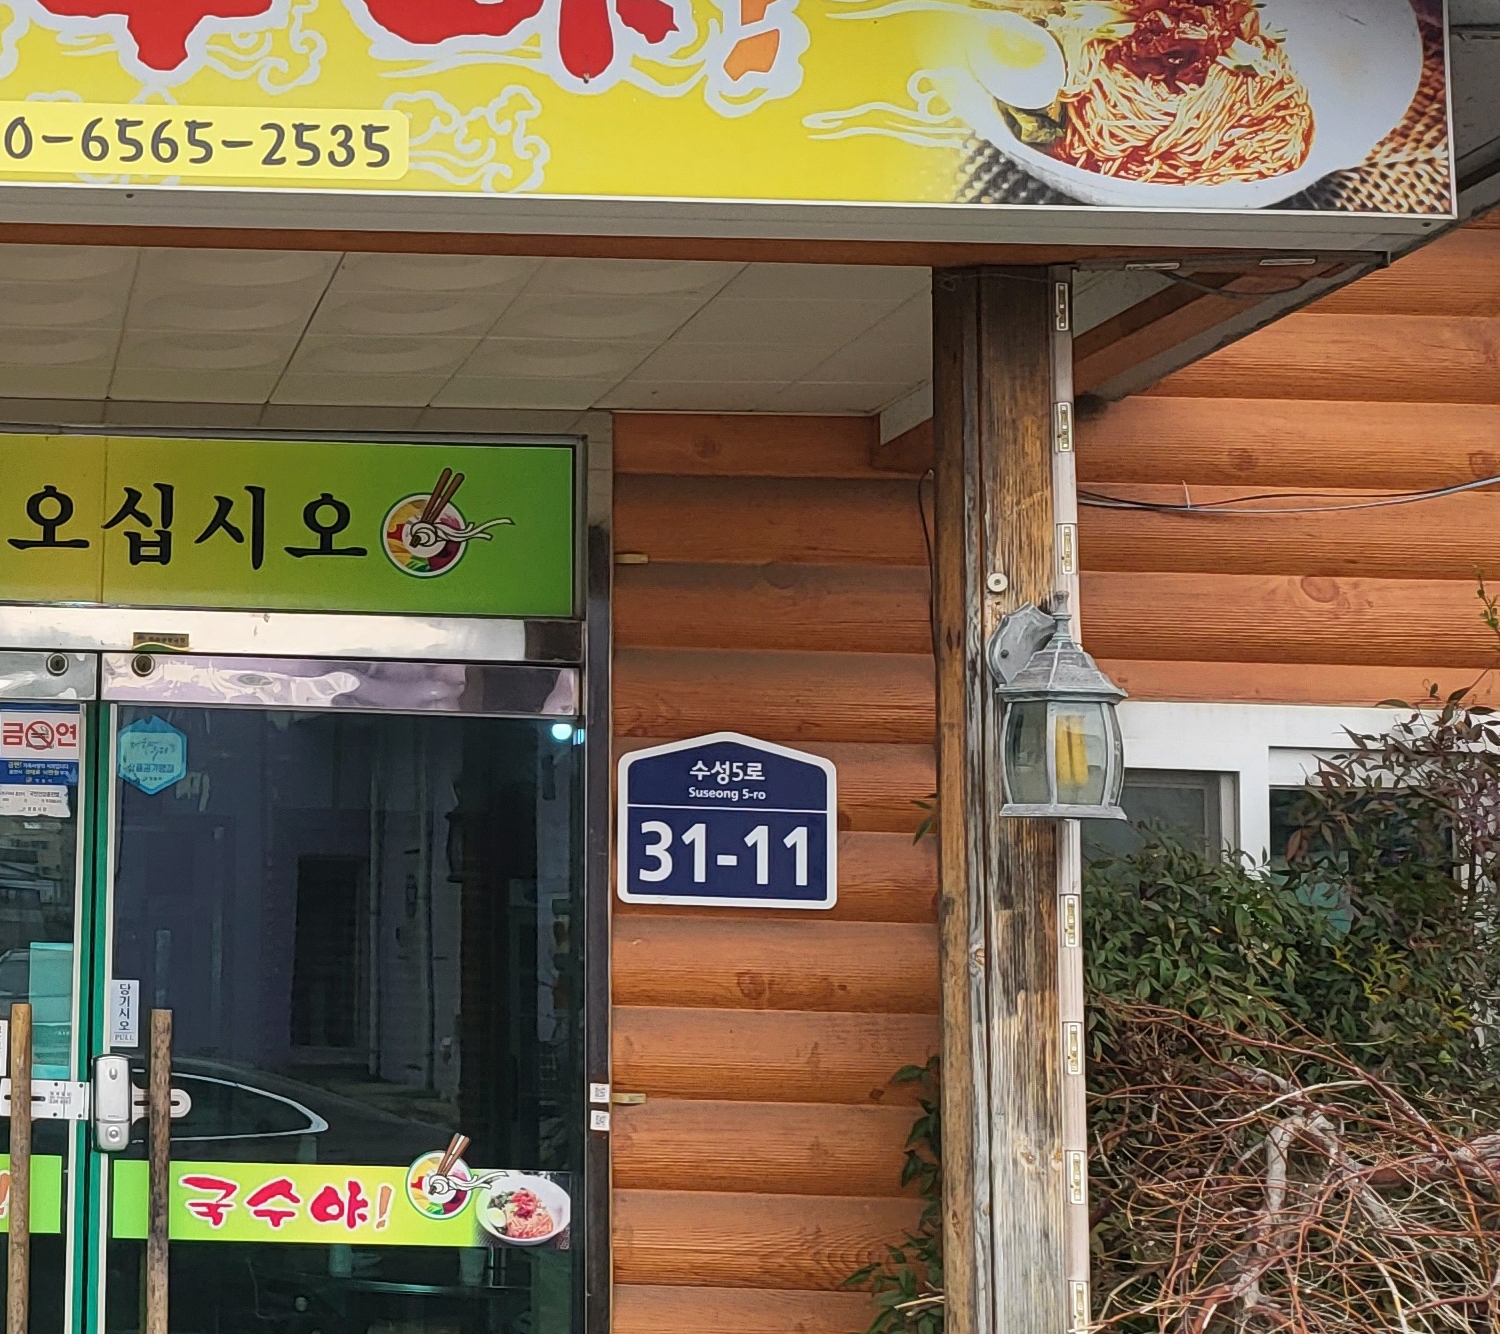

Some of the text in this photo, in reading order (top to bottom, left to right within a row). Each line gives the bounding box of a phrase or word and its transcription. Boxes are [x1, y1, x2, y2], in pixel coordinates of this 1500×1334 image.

[2, 721, 77, 748] 금연
[689, 759, 766, 786] 수성5로
[688, 786, 767, 801] Suseong 5-ro
[638, 819, 809, 887] 31-11
[117, 982, 132, 1032] 당기시오
[113, 1033, 135, 1042] PULL
[180, 1174, 393, 1230] 국수야!
